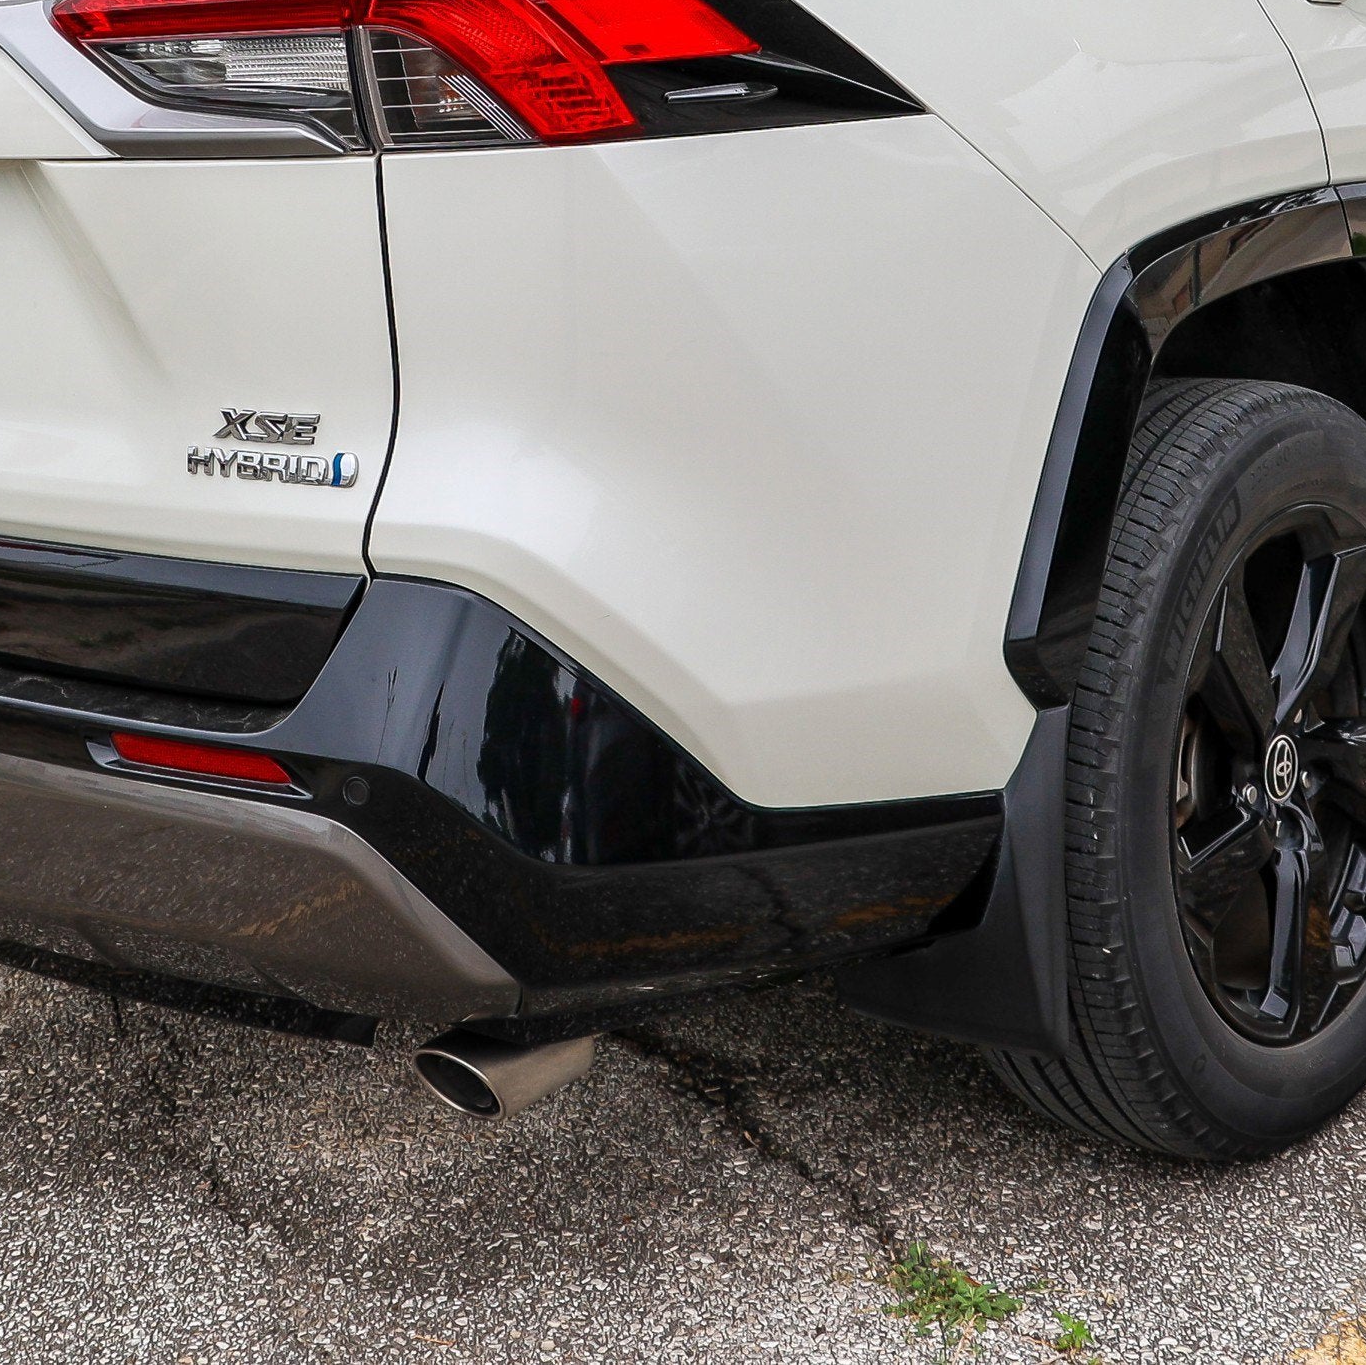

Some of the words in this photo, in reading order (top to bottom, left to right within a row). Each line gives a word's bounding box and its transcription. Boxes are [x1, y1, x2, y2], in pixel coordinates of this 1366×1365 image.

[212, 407, 321, 445] XSE
[187, 445, 329, 485] HYBRID
[1165, 499, 1238, 672] MICHELIN
